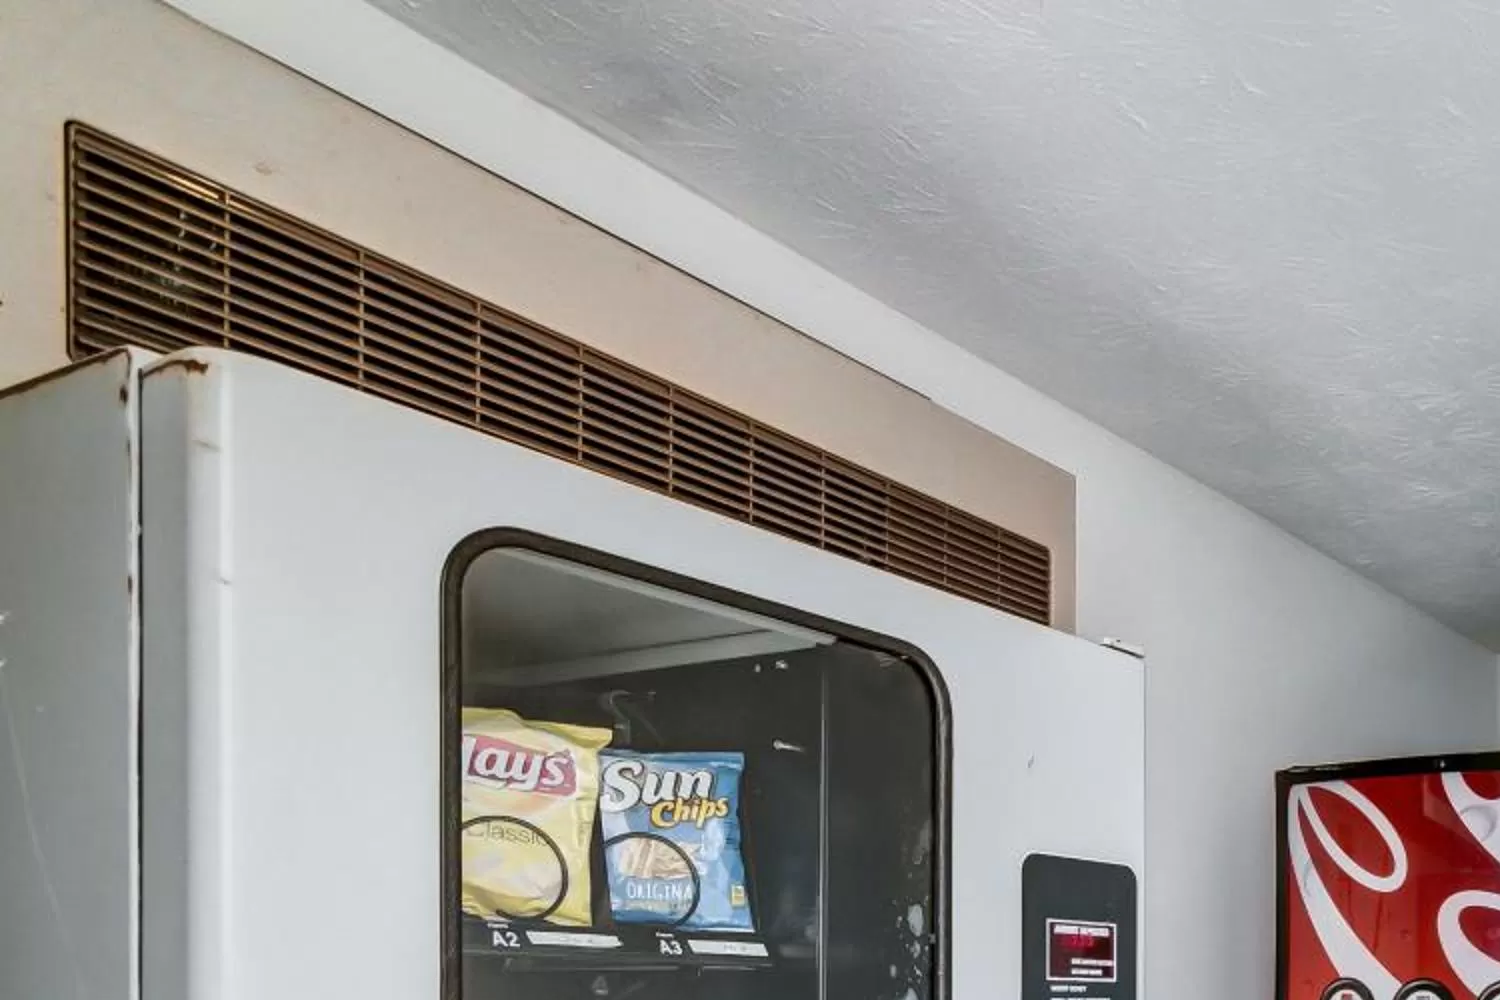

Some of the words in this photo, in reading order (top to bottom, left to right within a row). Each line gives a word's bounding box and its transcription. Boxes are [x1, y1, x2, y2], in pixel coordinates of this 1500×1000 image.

[601, 759, 713, 813] Sun
[651, 797, 729, 829] Chips
[492, 931, 521, 948] A2
[659, 938, 683, 955] A3
